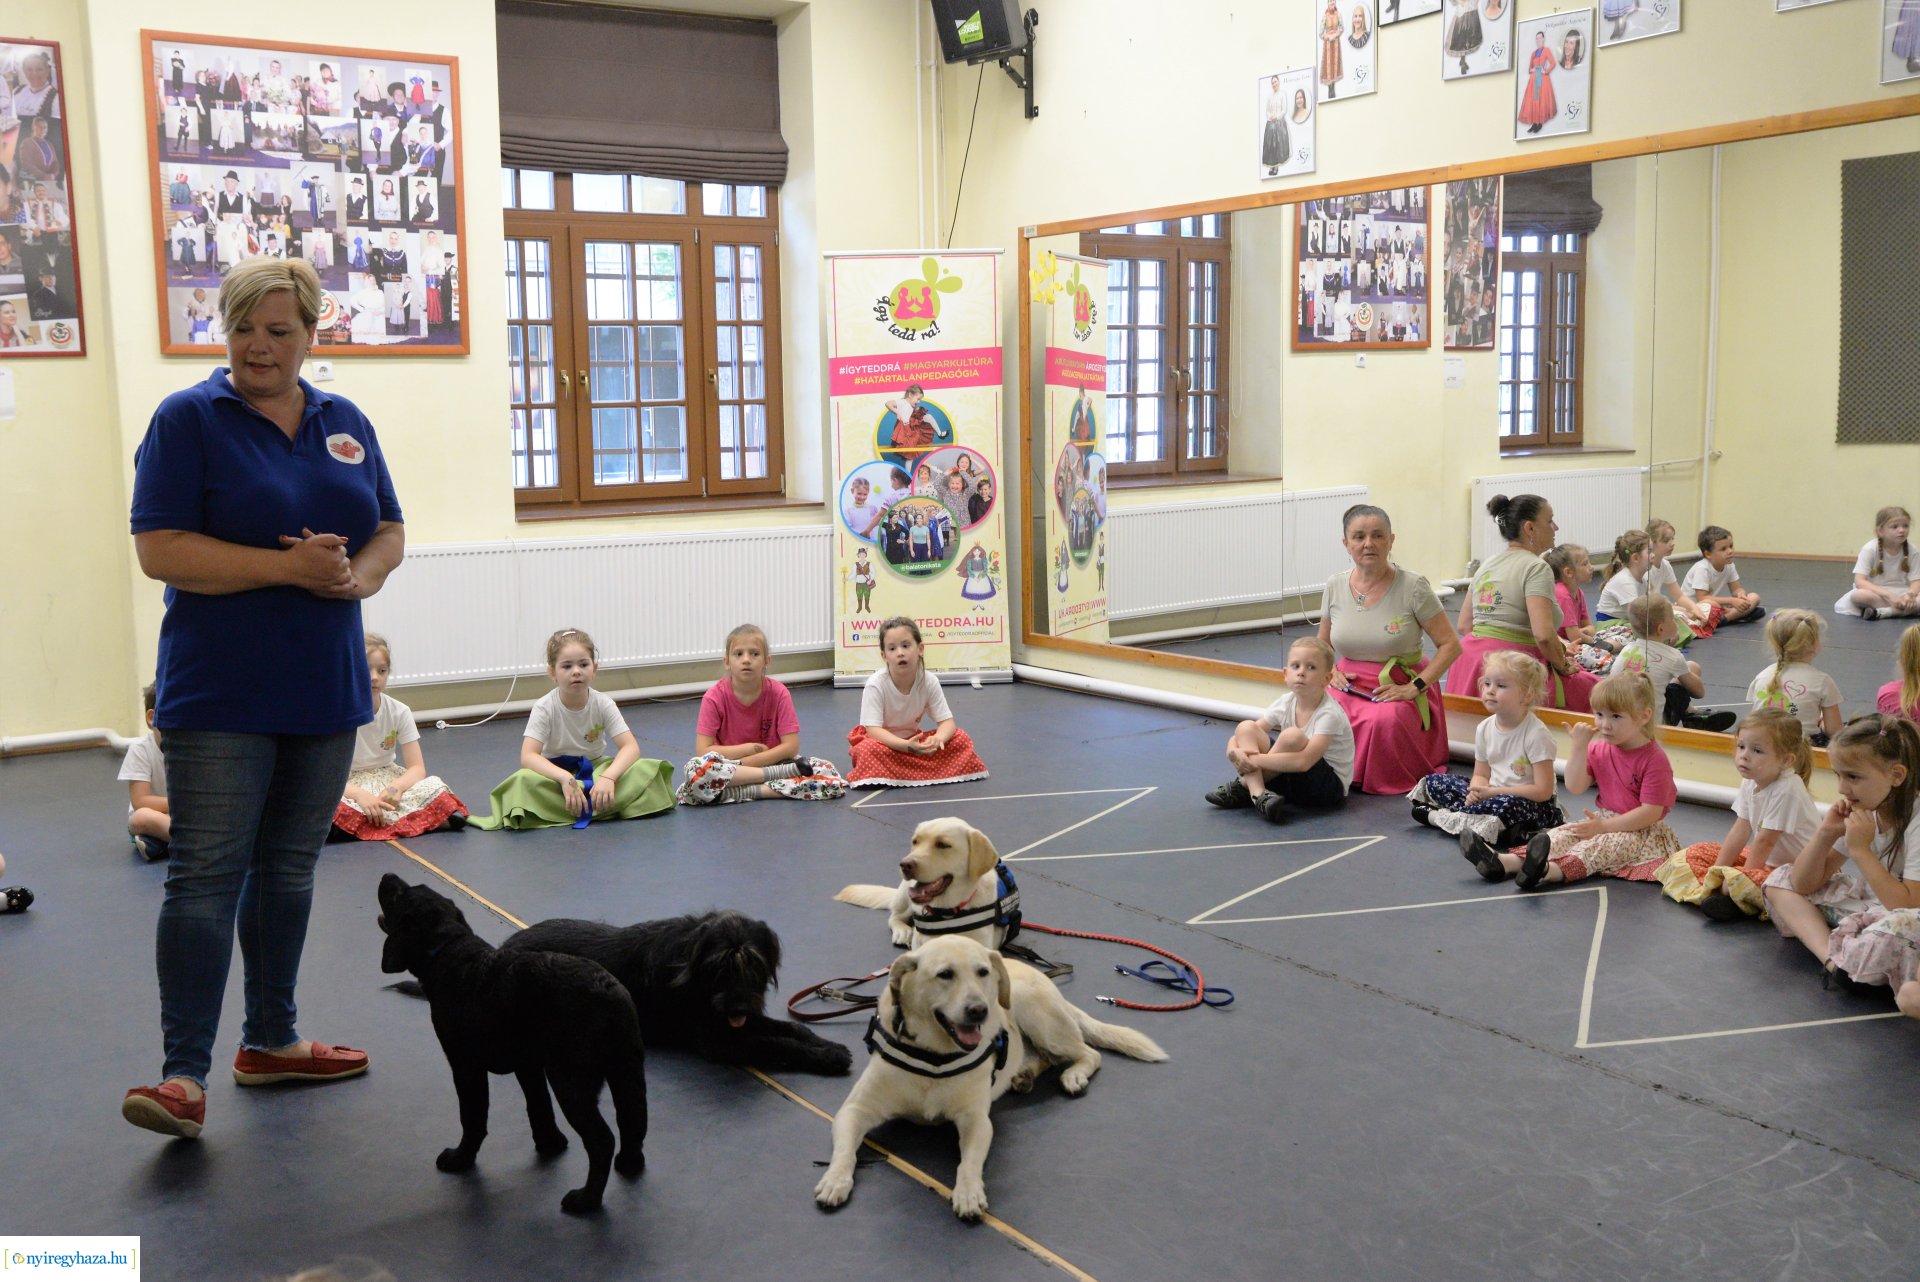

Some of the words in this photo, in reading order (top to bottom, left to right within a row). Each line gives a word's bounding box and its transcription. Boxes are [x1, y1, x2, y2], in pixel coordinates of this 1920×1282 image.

[888, 323, 916, 341] tedd
[921, 320, 940, 340] rá!
[839, 361, 900, 375] #ÍGYTEDDRÁ
[903, 357, 993, 371] #MAGYARKULTÚRA
[854, 369, 979, 385] #HATÁRTALANPEDAGÓGIA
